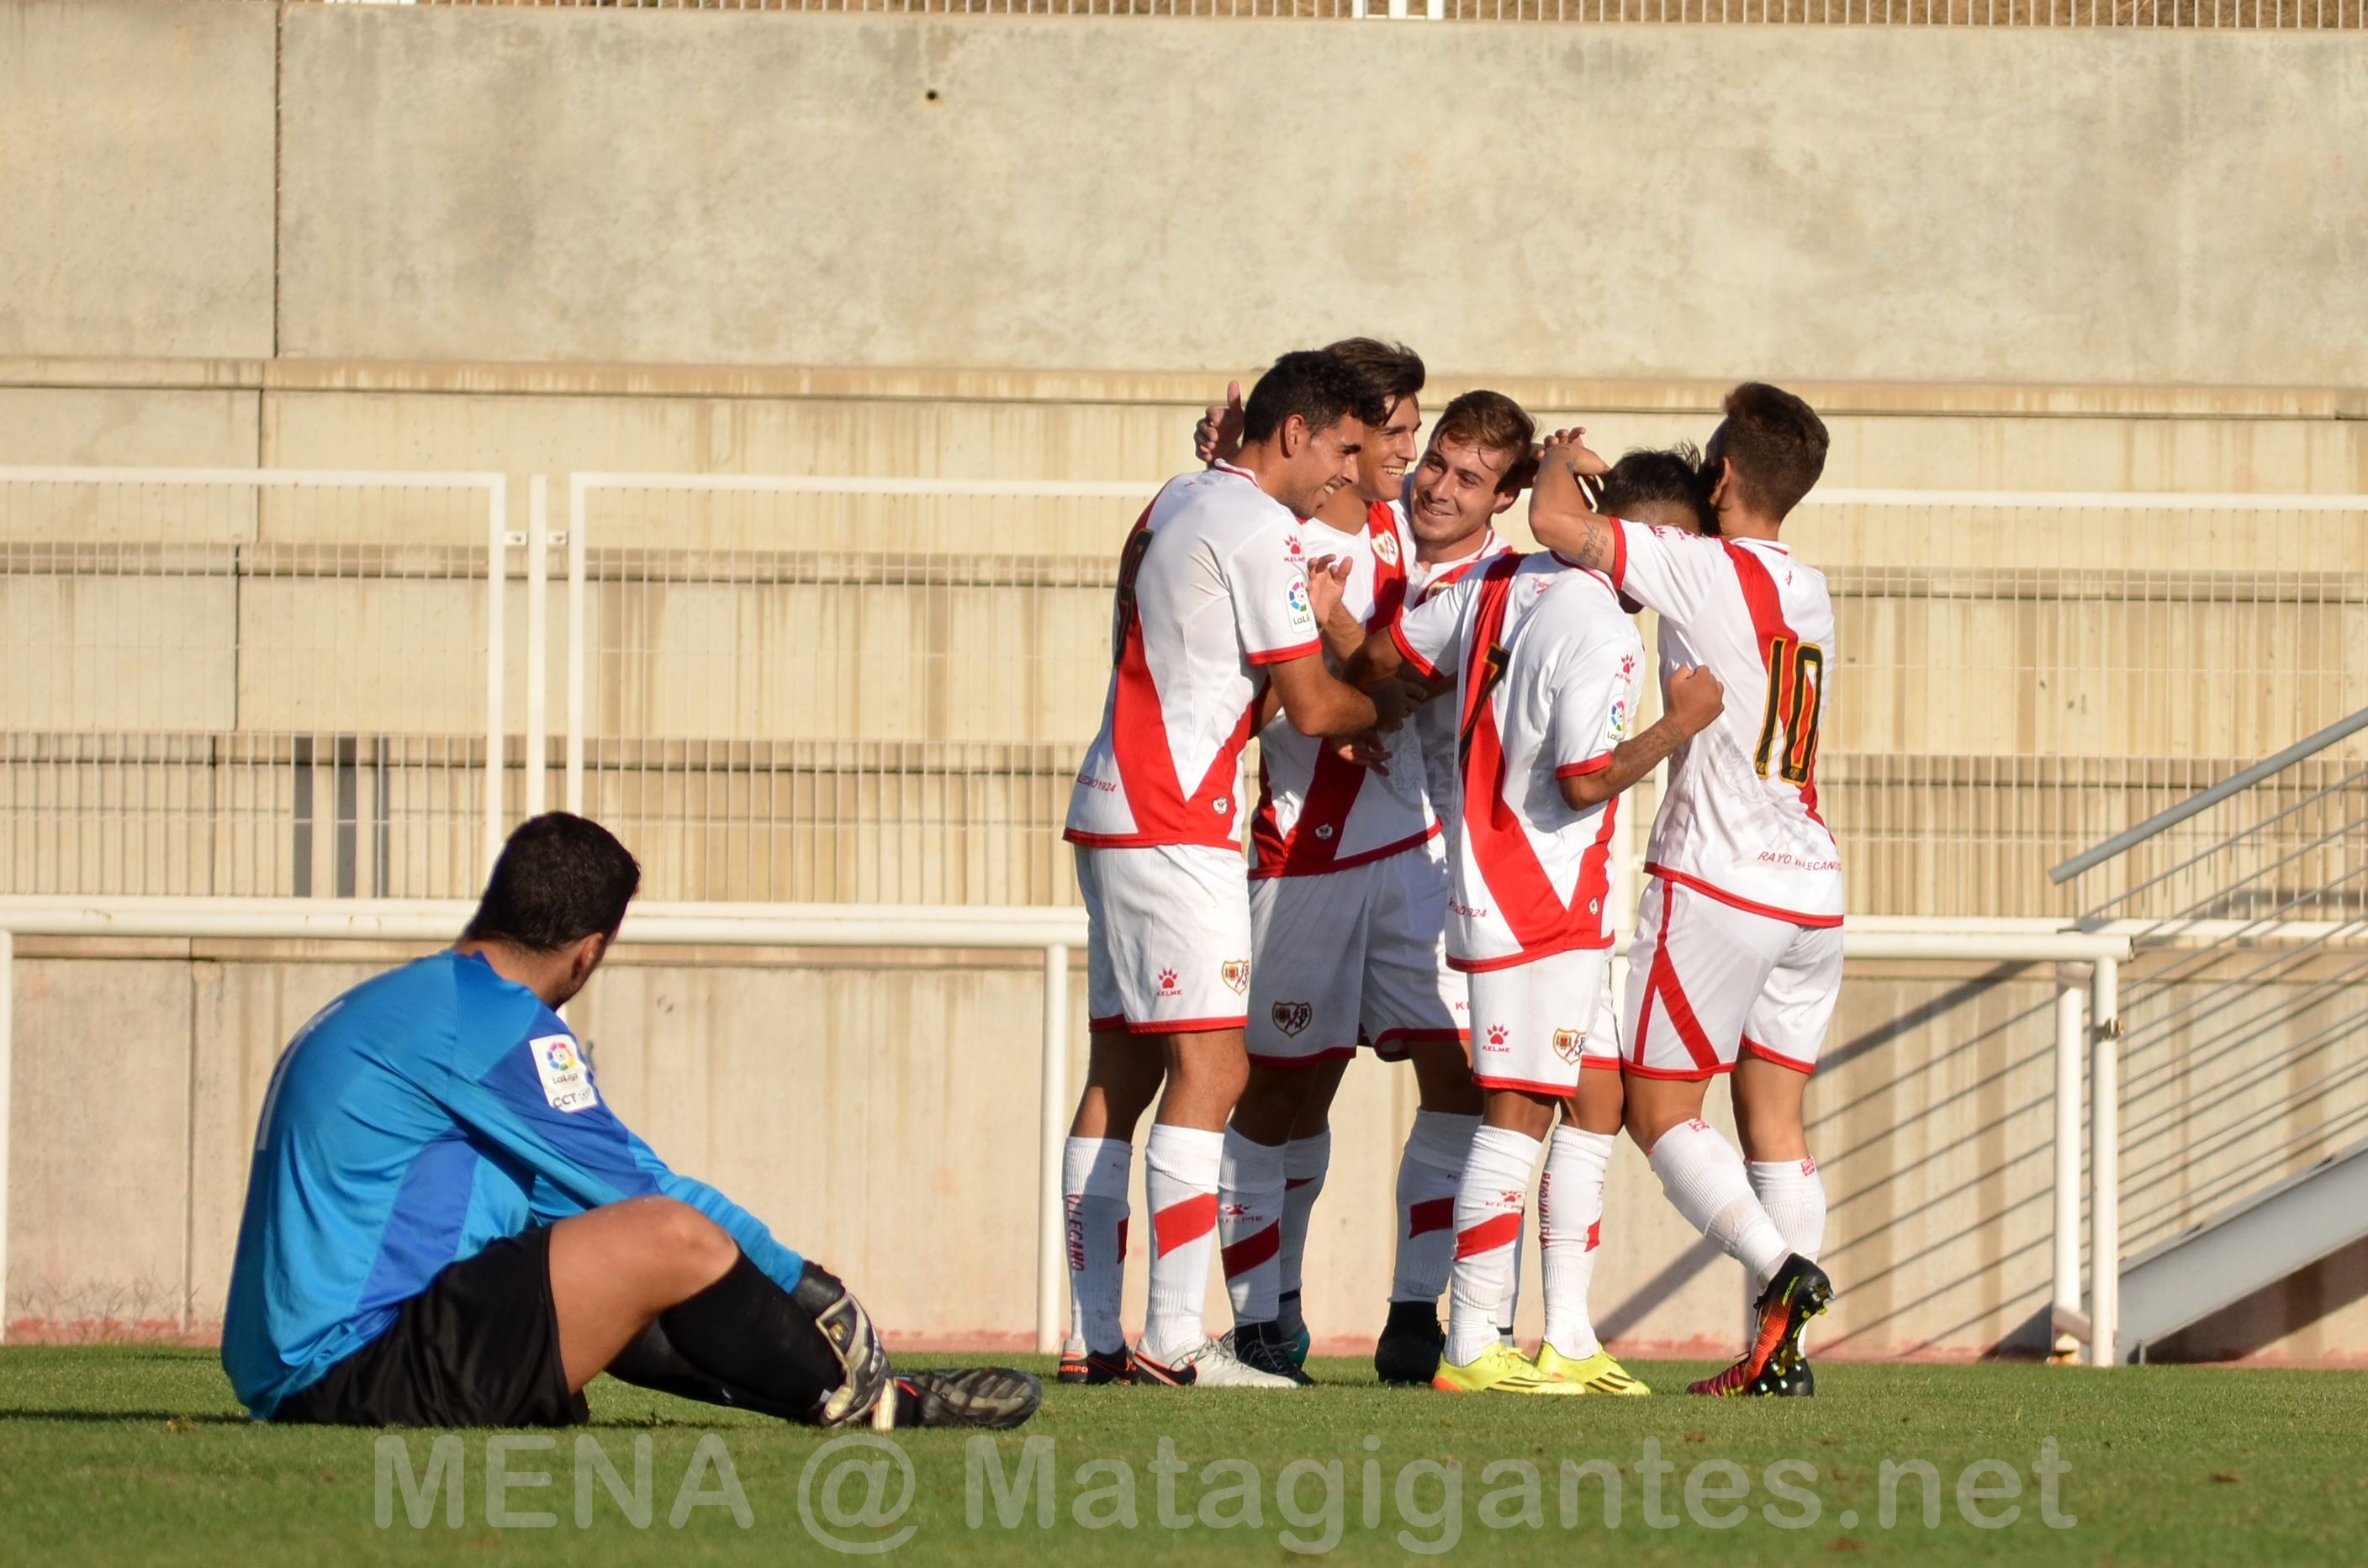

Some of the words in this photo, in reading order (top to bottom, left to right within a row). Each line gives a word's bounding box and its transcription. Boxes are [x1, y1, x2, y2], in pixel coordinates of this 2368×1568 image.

[1752, 635, 1823, 788] 10
[1757, 851, 1792, 864] RAYO
[552, 1092, 577, 1108] CCT
